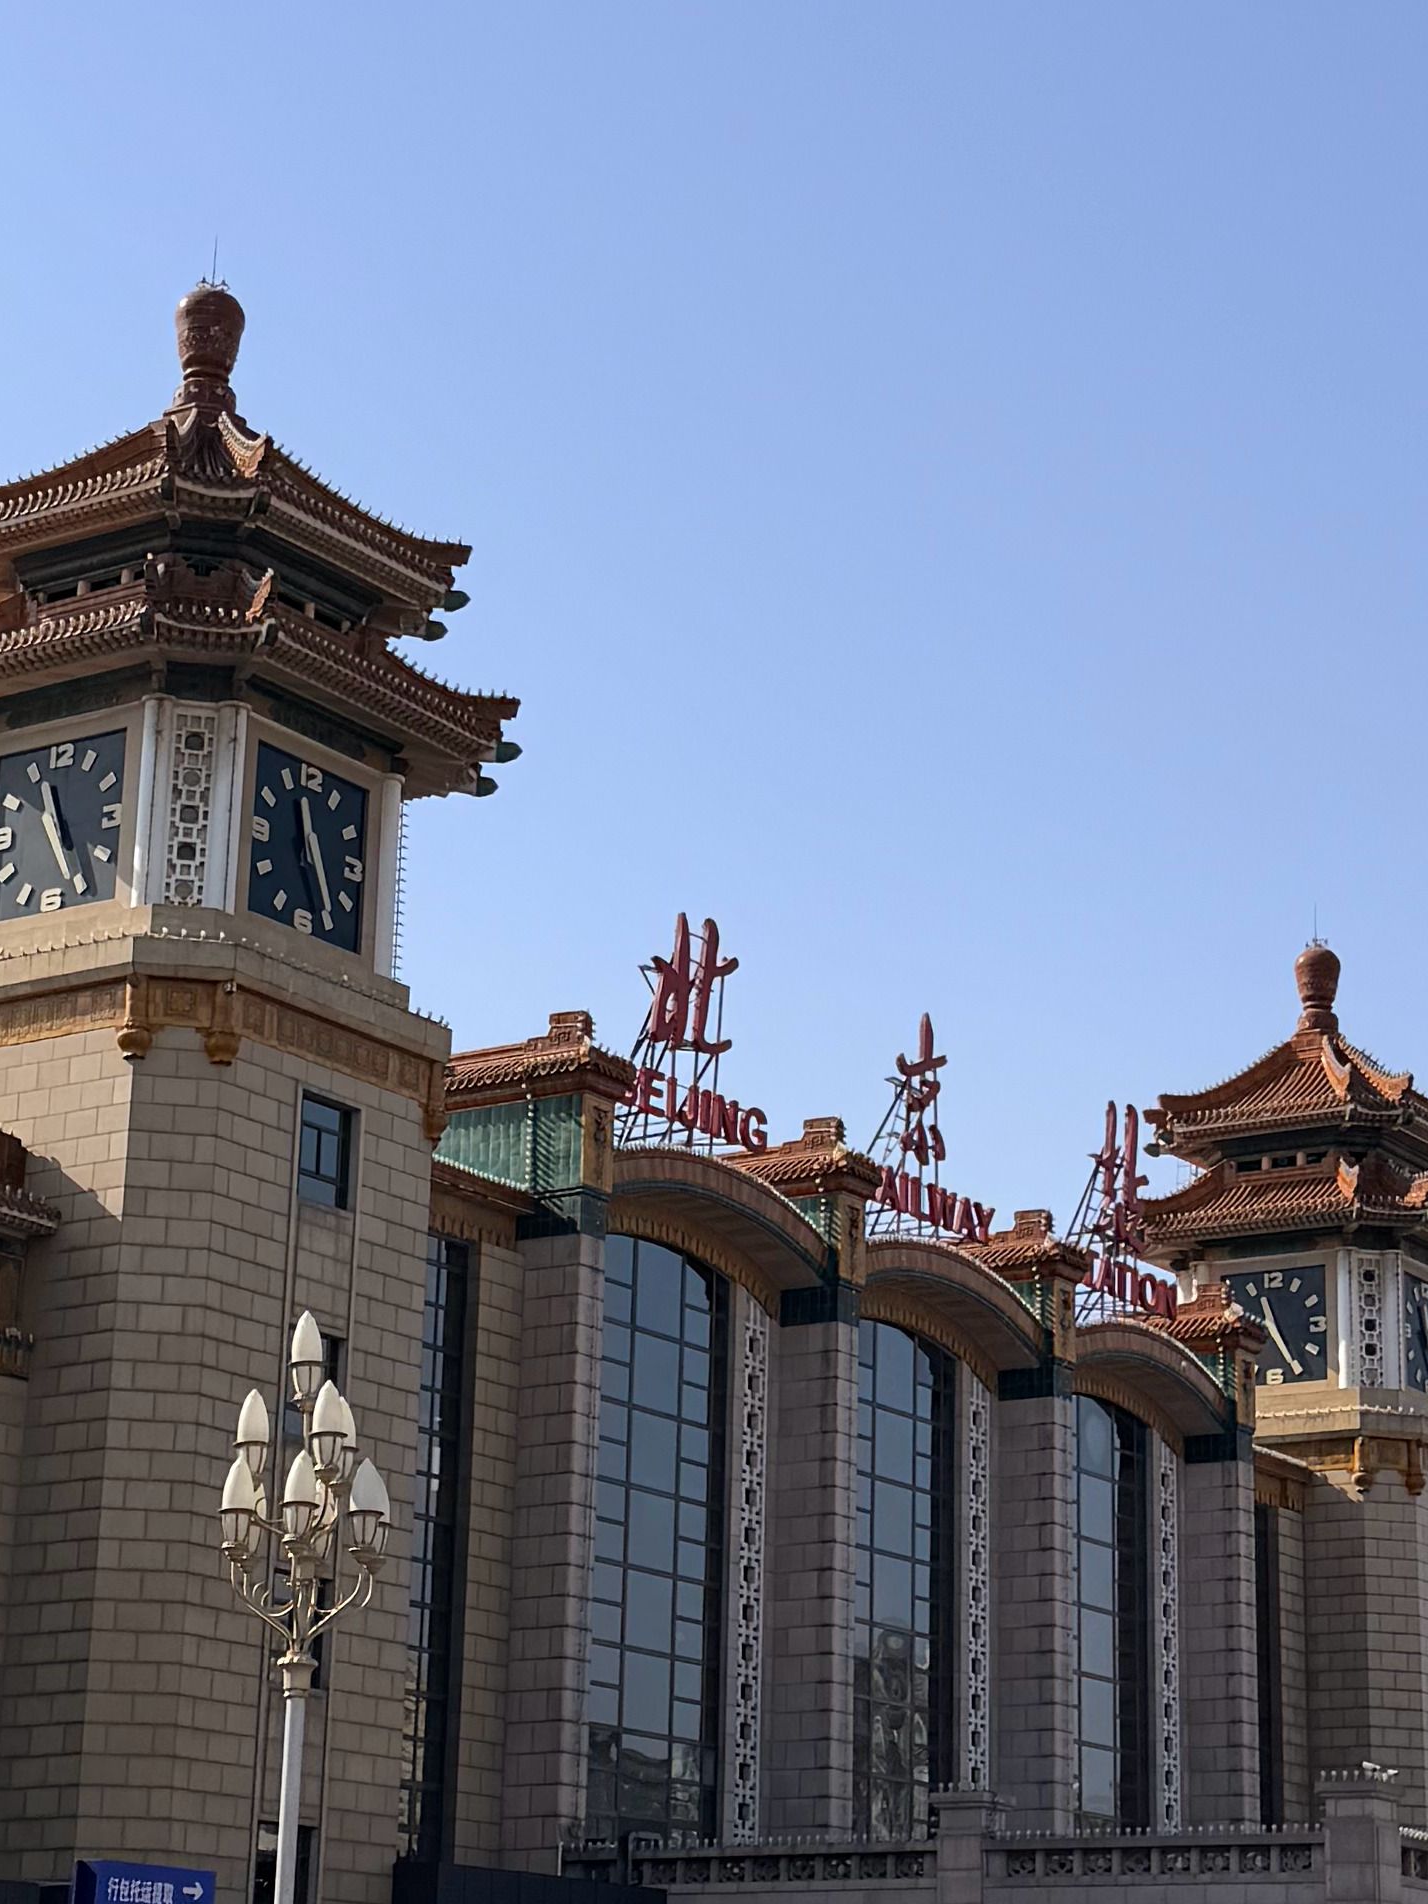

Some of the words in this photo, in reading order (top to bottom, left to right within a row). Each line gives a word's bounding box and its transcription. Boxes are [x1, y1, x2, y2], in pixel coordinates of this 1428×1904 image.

[49, 743, 75, 770] 12
[300, 763, 324, 793] 12
[102, 803, 123, 830] 3
[252, 815, 270, 843] 9
[344, 854, 364, 883] 3
[40, 887, 63, 913] 6
[293, 907, 313, 936] 6
[650, 911, 739, 1056] 北
[875, 1165, 996, 1247] AILWAY
[1263, 1271, 1284, 1289] 12
[1309, 1315, 1327, 1333] 3
[1265, 1368, 1284, 1386] 6
